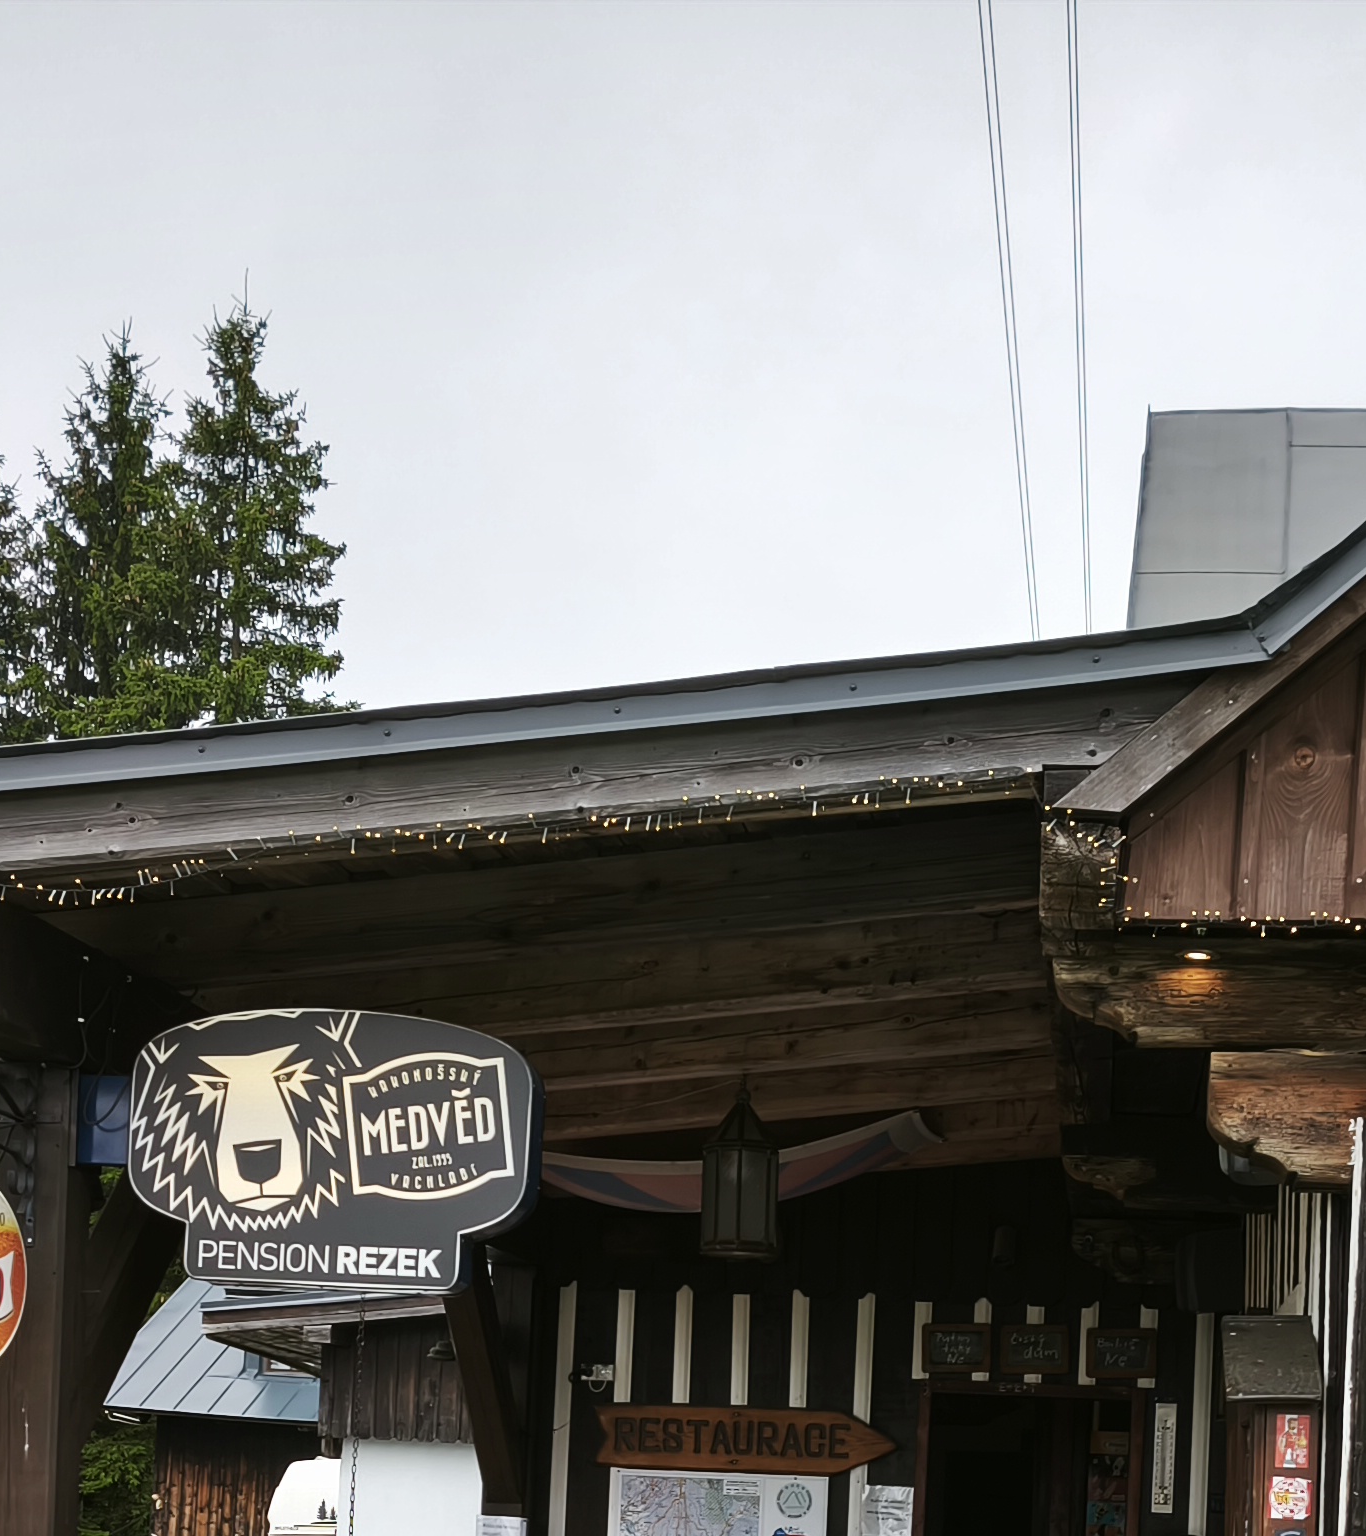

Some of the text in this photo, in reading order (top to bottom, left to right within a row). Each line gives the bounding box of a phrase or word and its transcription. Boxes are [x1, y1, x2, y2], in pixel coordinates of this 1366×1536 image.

[360, 1087, 497, 1156] MEDVĚD
[197, 1239, 443, 1279] PENSION REZEK
[613, 1416, 852, 1460] RESTAURACE
